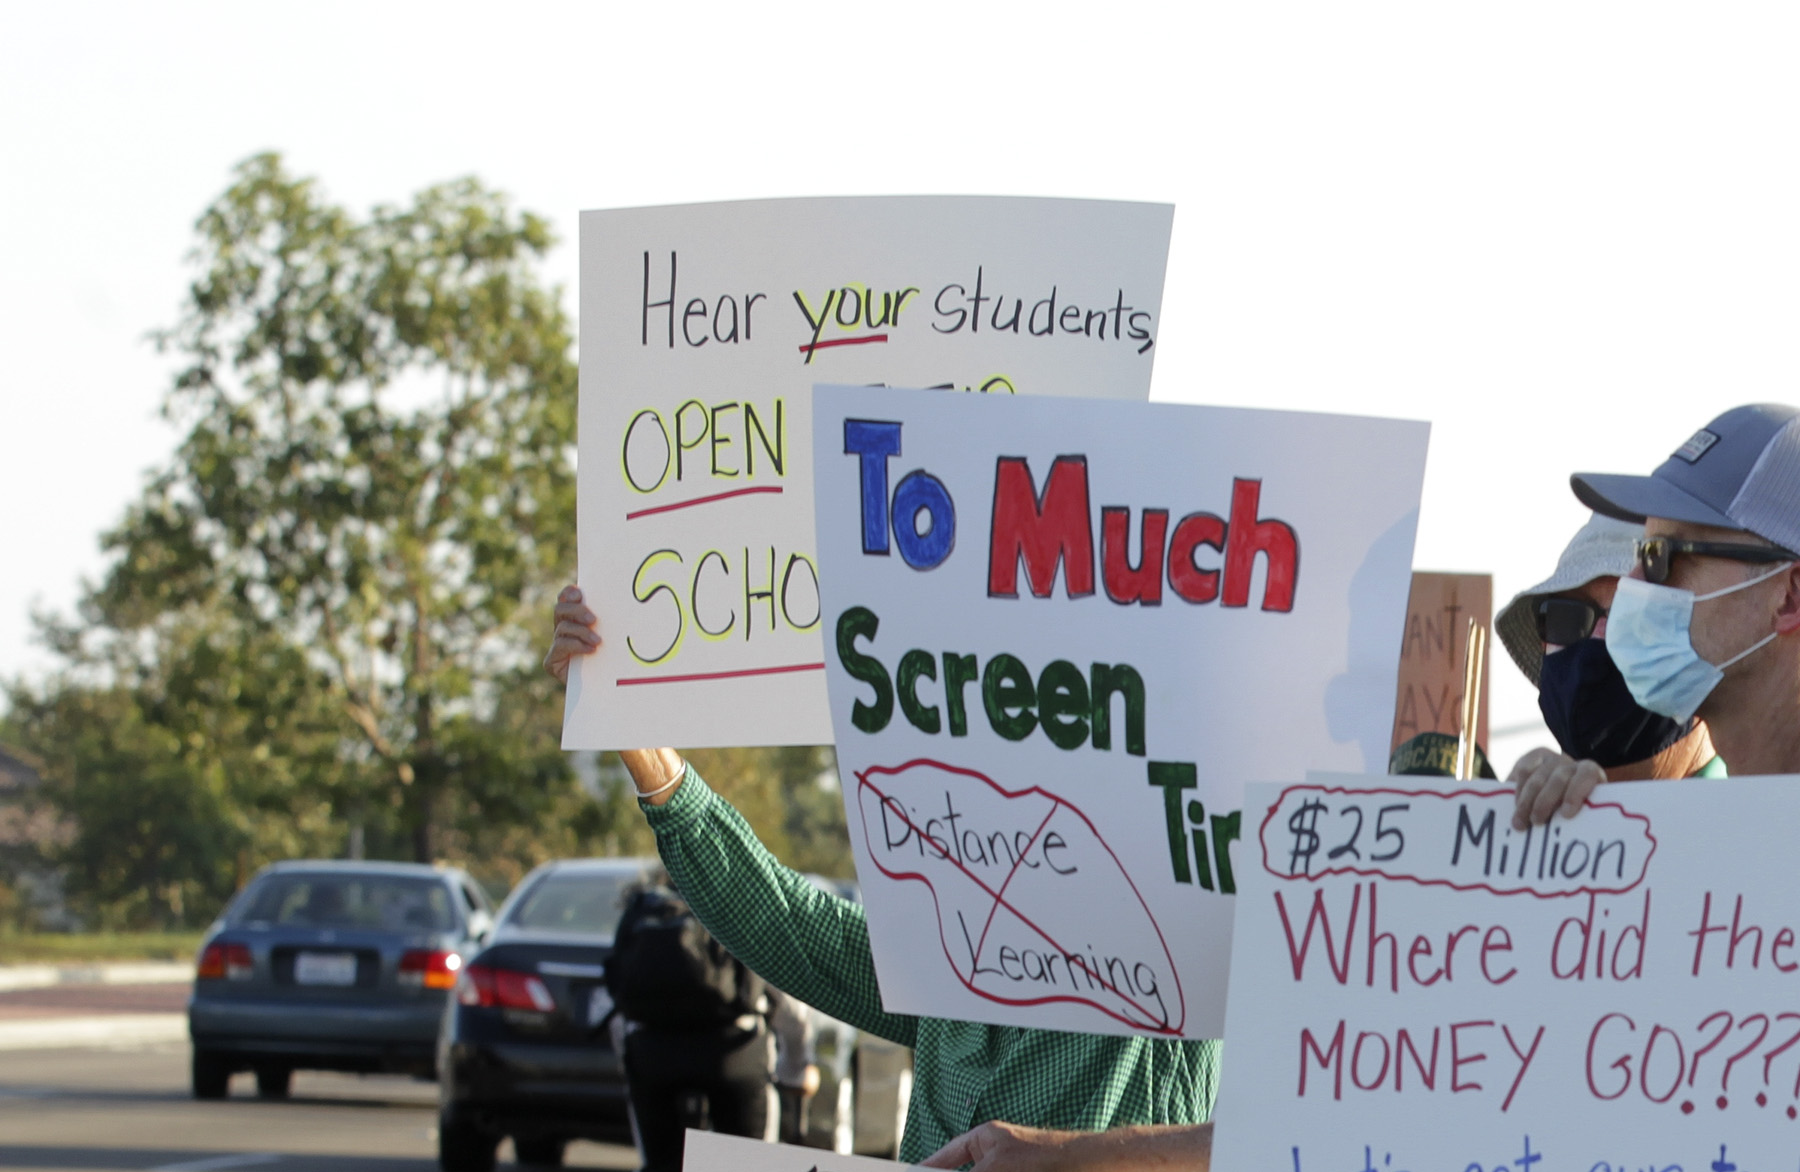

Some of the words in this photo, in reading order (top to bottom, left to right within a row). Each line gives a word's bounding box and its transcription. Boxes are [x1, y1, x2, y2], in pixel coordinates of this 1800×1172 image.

[642, 250, 767, 348] Hear
[792, 283, 919, 363] your
[622, 398, 786, 493] OPEN
[843, 417, 957, 572] To
[987, 453, 1301, 614] Much
[625, 545, 821, 664] SCHO
[1401, 586, 1462, 669] ANT
[836, 605, 1147, 757] Screen
[880, 791, 1079, 876] Distance
[1288, 797, 1411, 876] $25
[1451, 802, 1626, 881] Million
[957, 911, 1169, 1032] Learning
[1273, 882, 1518, 994] Where
[1550, 888, 1652, 982] did
[1686, 890, 1800, 978] the
[1297, 1019, 1546, 1112] MONEY
